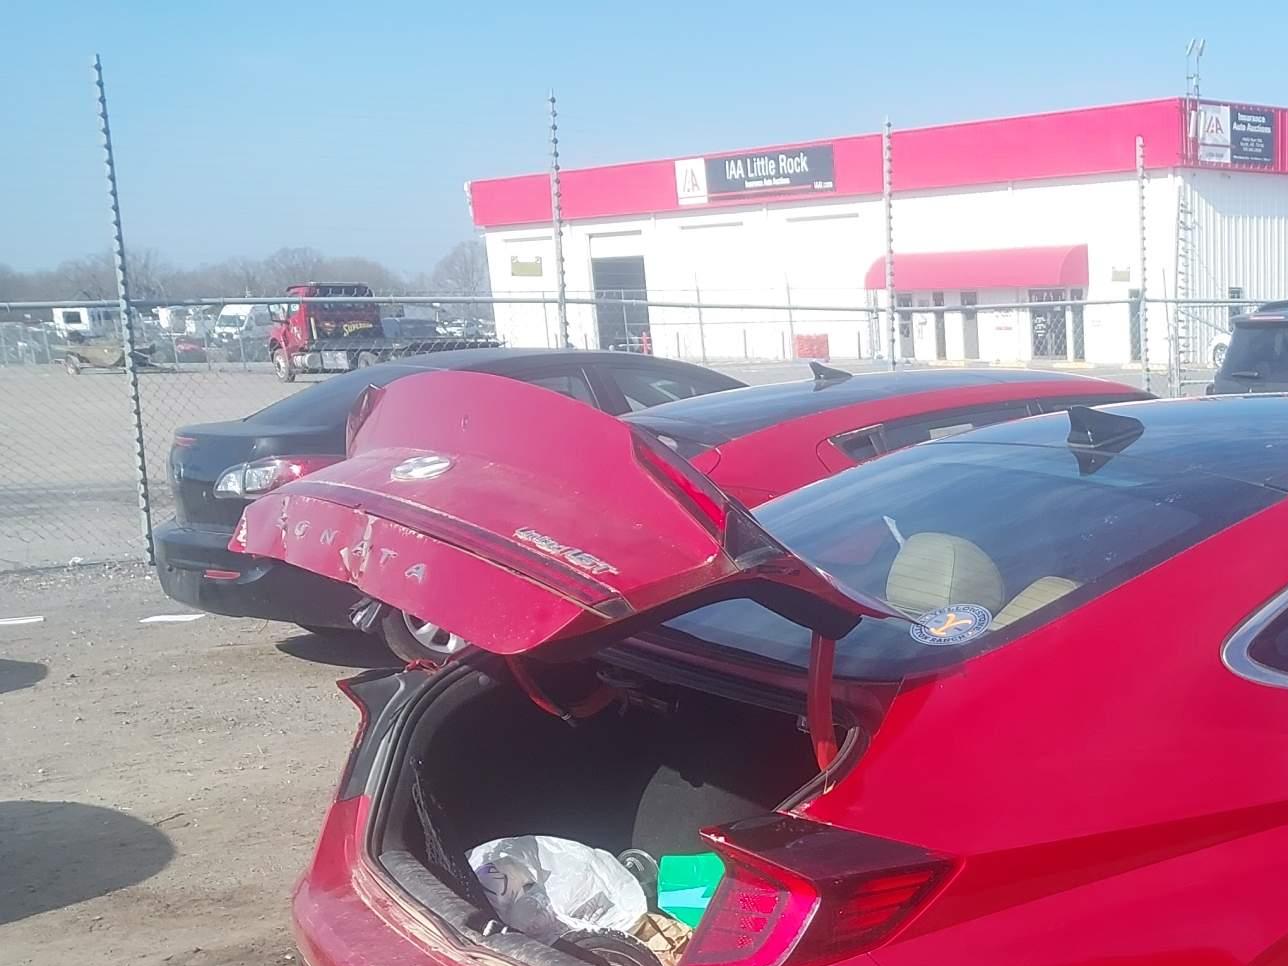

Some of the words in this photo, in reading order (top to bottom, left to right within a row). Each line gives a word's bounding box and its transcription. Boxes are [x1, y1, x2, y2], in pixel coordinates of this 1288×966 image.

[725, 159, 745, 180] IAA
[747, 155, 776, 177] Little
[778, 152, 809, 174] Rock
